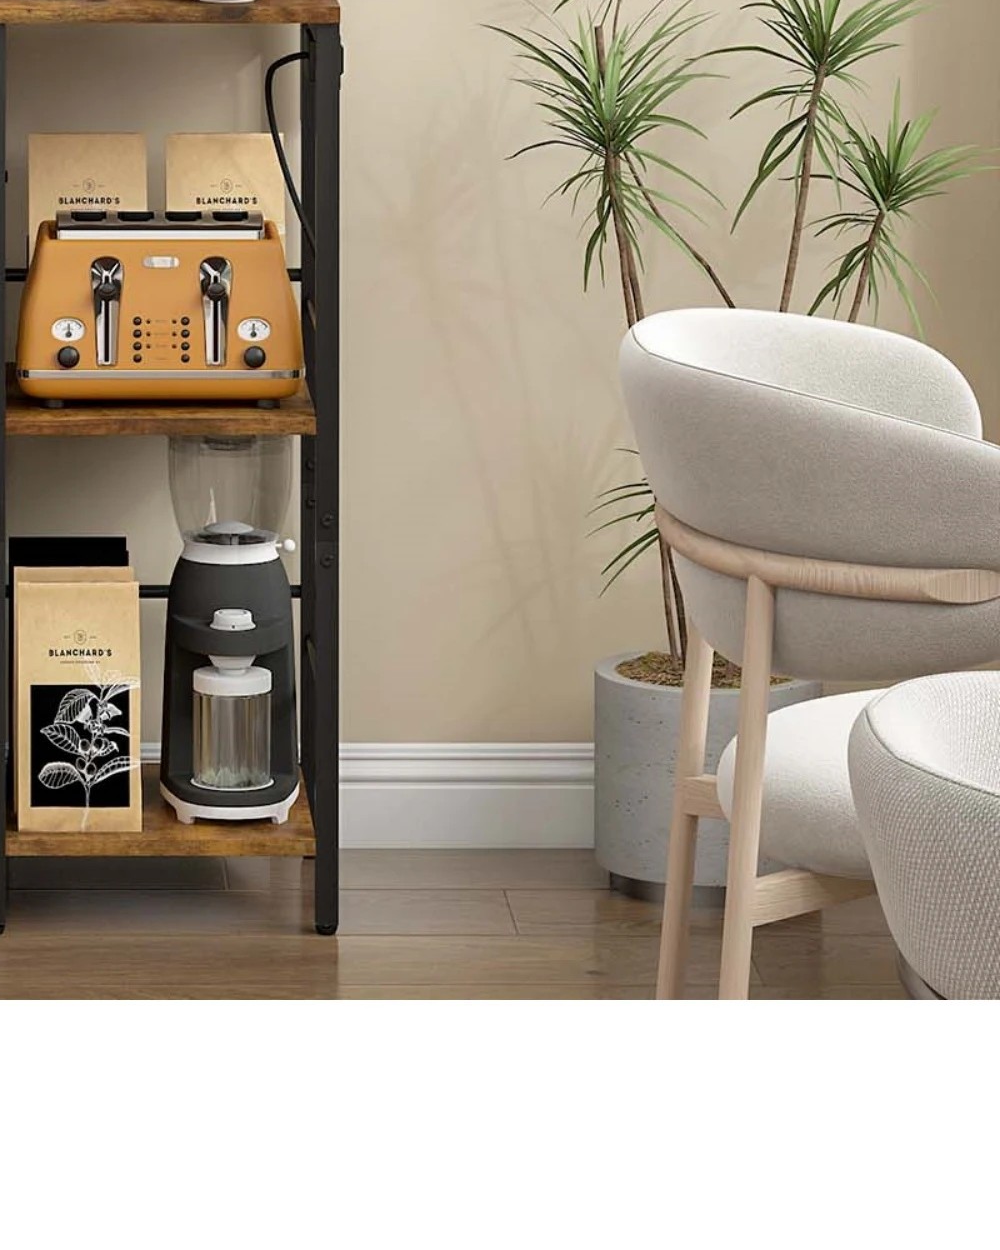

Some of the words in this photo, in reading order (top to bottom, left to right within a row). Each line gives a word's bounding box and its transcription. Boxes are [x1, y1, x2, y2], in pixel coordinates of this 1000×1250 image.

[59, 197, 120, 205] BLANCHARD'S
[196, 197, 258, 205] BLANCHARD'S
[49, 649, 112, 657] BLANCHARD'S
